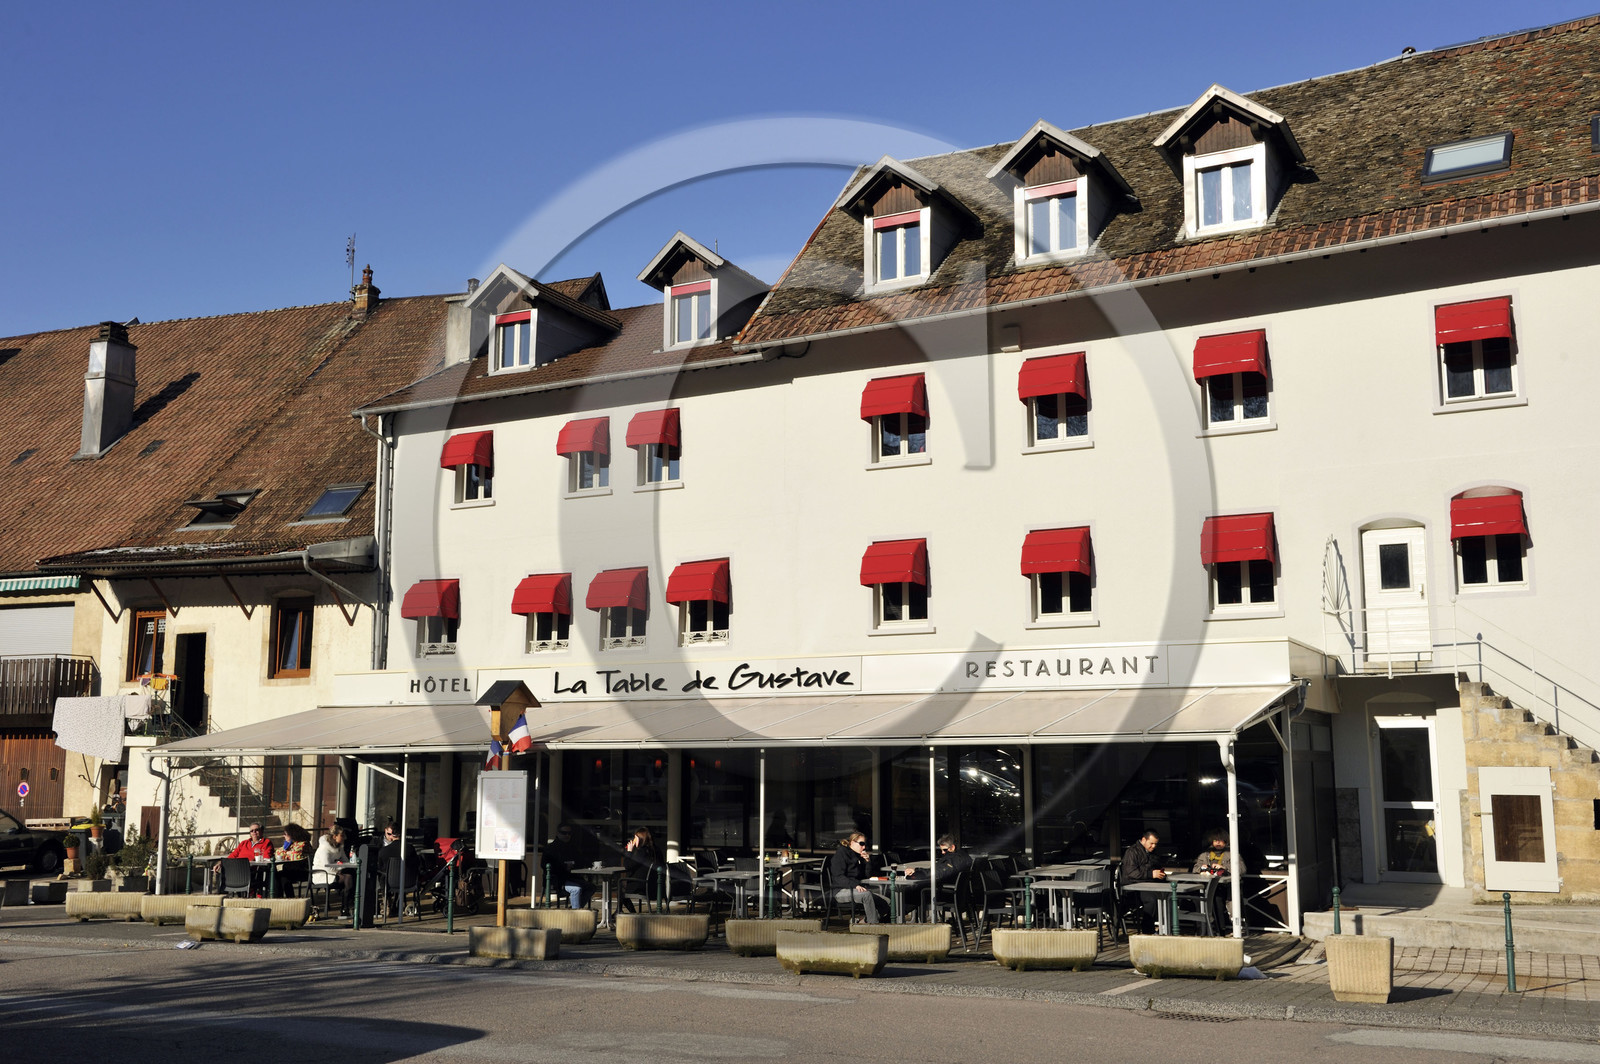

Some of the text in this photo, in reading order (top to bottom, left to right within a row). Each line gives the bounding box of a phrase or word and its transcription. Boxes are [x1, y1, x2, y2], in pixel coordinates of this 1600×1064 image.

[553, 663, 854, 694] La Table de Gustave
[965, 655, 1159, 679] RESTAURANT
[410, 676, 471, 694] HÔTEL
